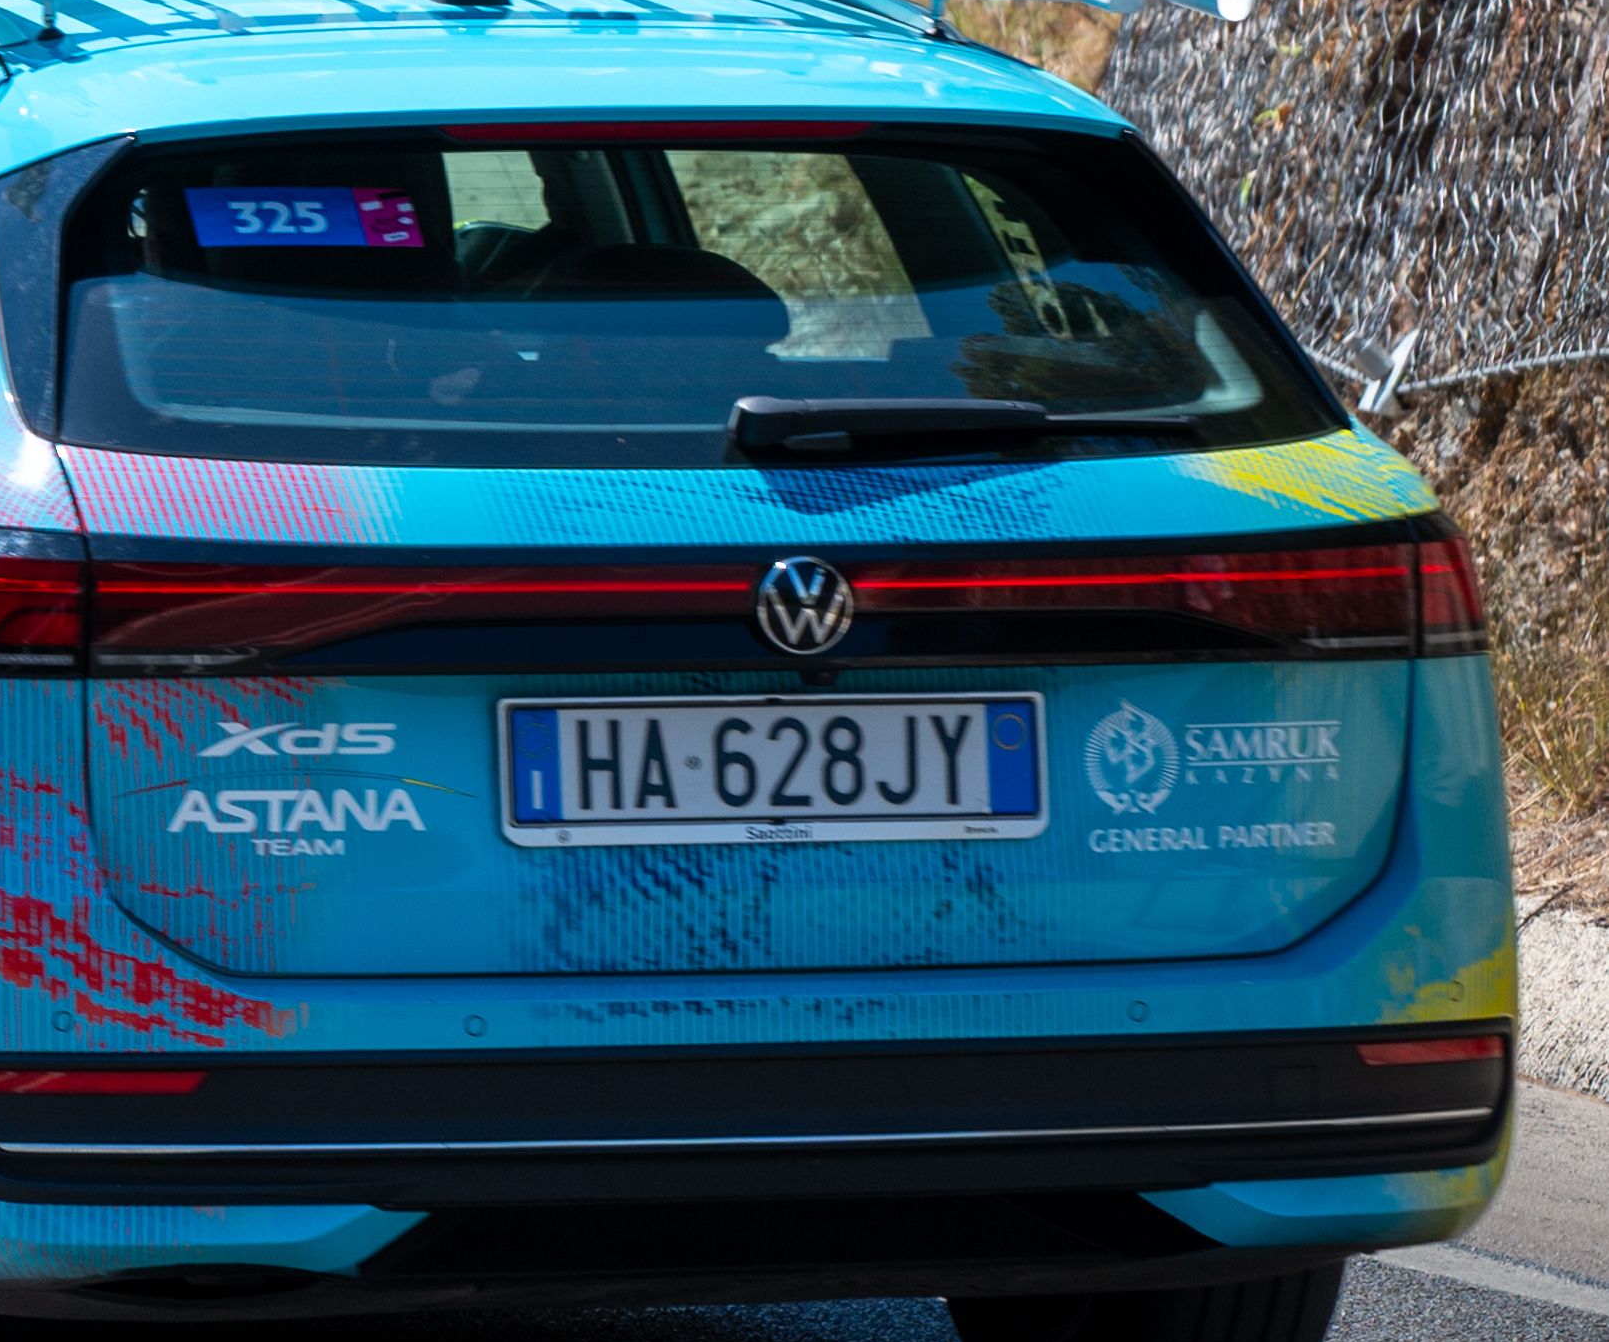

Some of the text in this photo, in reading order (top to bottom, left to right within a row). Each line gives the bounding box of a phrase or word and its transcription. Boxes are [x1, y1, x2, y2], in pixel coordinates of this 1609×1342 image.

[227, 201, 328, 234] 325
[1184, 726, 1341, 761] SAMRUK
[576, 714, 971, 810] HA 628JY
[1184, 764, 1341, 786] KAZYNA
[166, 788, 428, 834] ASTANA
[250, 838, 346, 857] TEAM
[1089, 820, 1336, 854] GENERAL PARTNER
